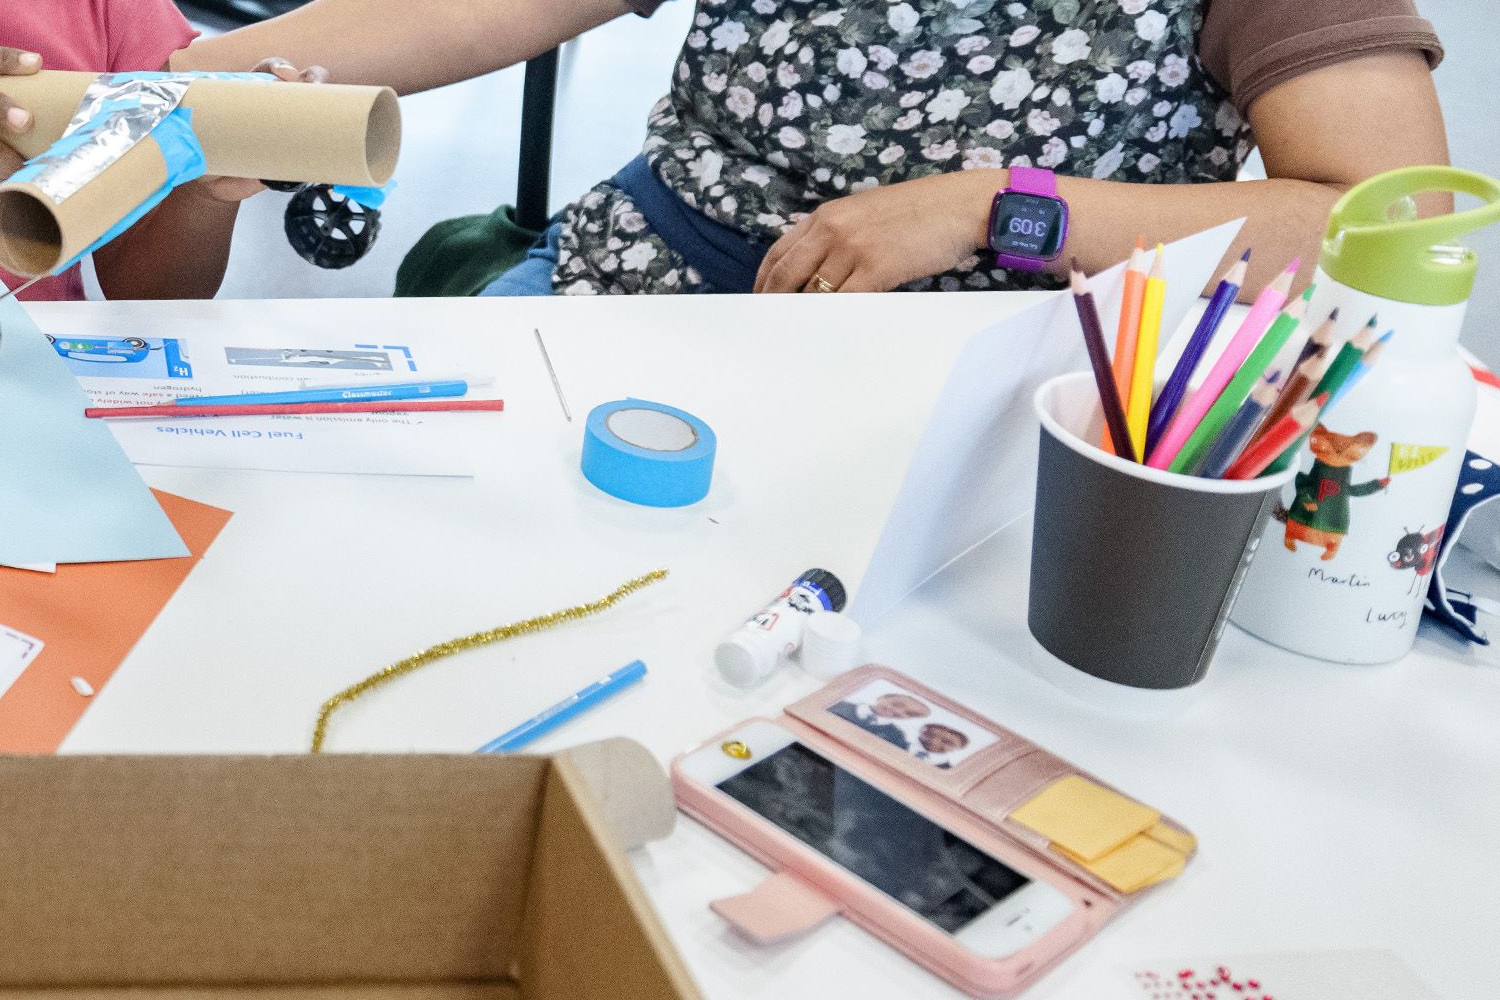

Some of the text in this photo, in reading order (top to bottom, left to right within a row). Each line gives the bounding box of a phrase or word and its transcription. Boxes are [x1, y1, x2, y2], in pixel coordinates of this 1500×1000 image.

[153, 385, 202, 393] hydrogen
[271, 413, 303, 421] water
[316, 415, 364, 423] emission
[156, 425, 304, 440] Fuel Cell Vehicles
[1317, 478, 1341, 503] P
[1308, 566, 1371, 588] Martin
[1366, 607, 1408, 630] Lucy
